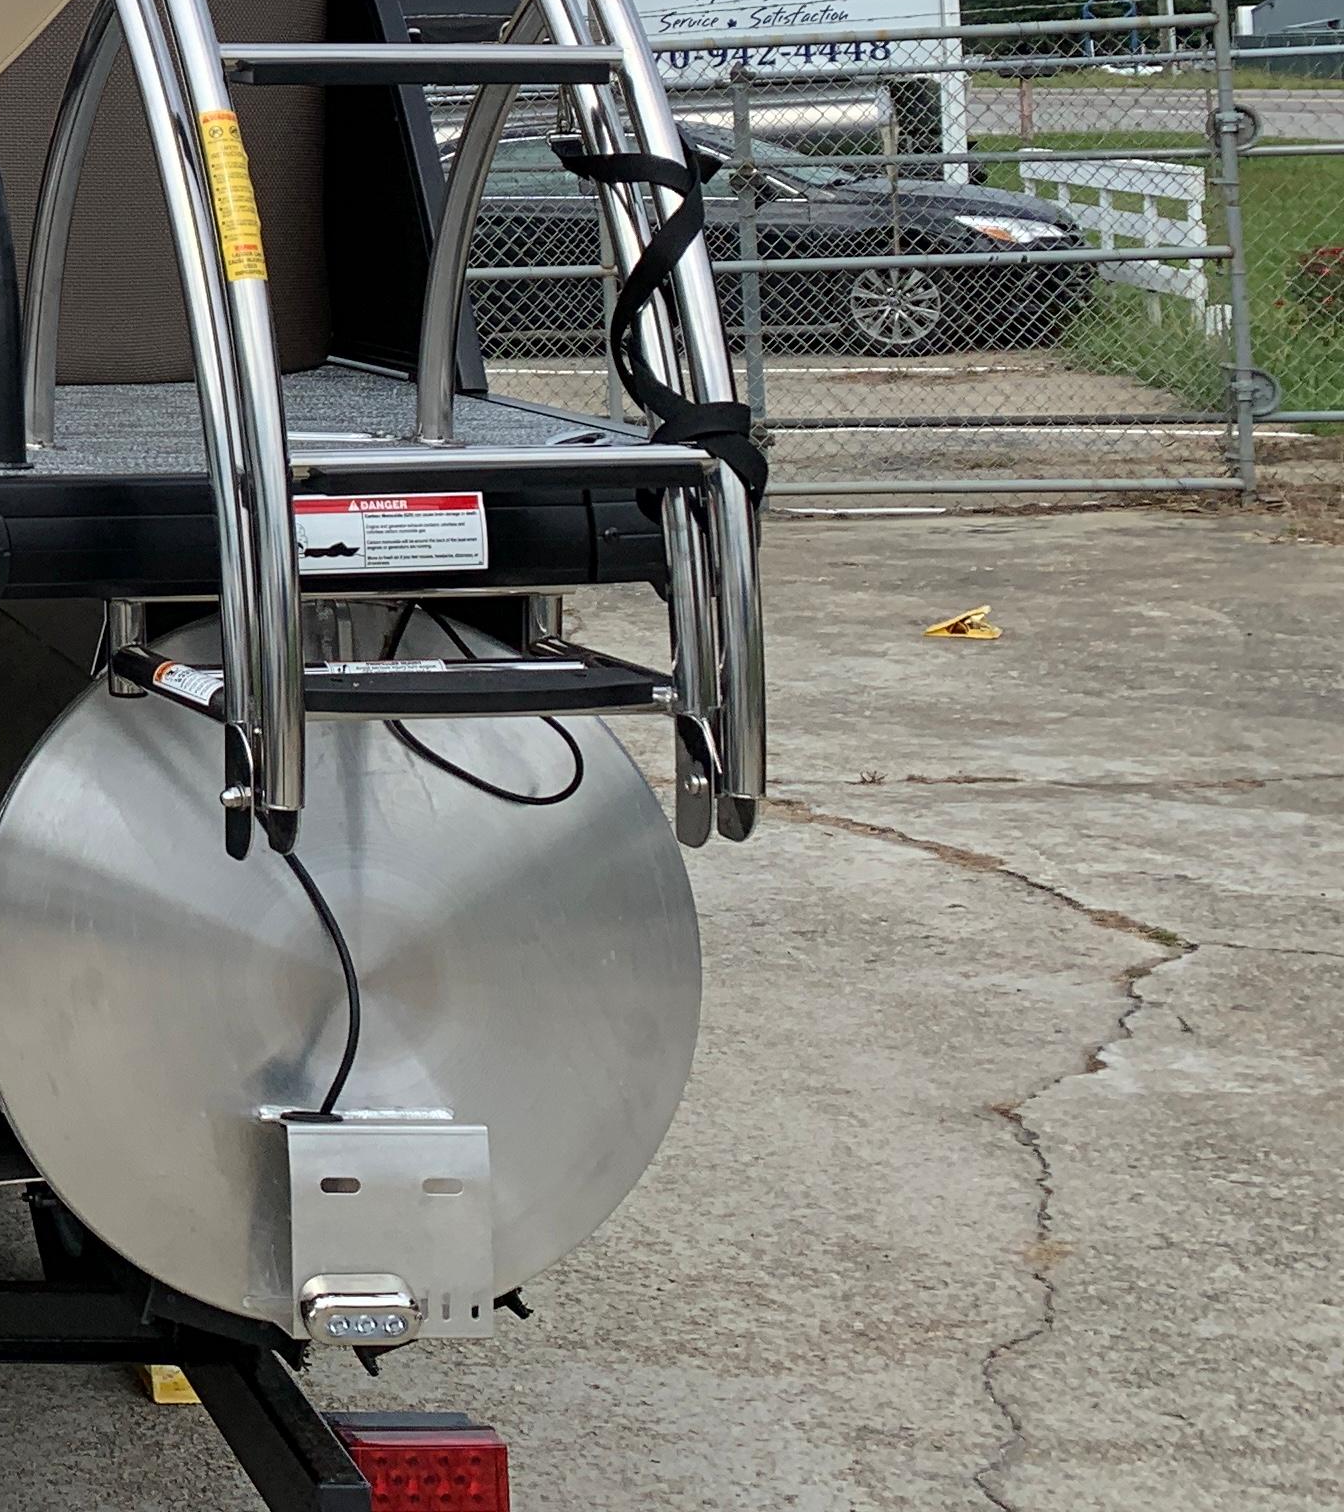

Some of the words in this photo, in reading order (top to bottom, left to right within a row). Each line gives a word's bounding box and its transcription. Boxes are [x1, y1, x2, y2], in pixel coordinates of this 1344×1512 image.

[658, 11, 720, 33] Service
[749, 3, 849, 29] Satisfaction
[359, 498, 409, 511] DANGER
